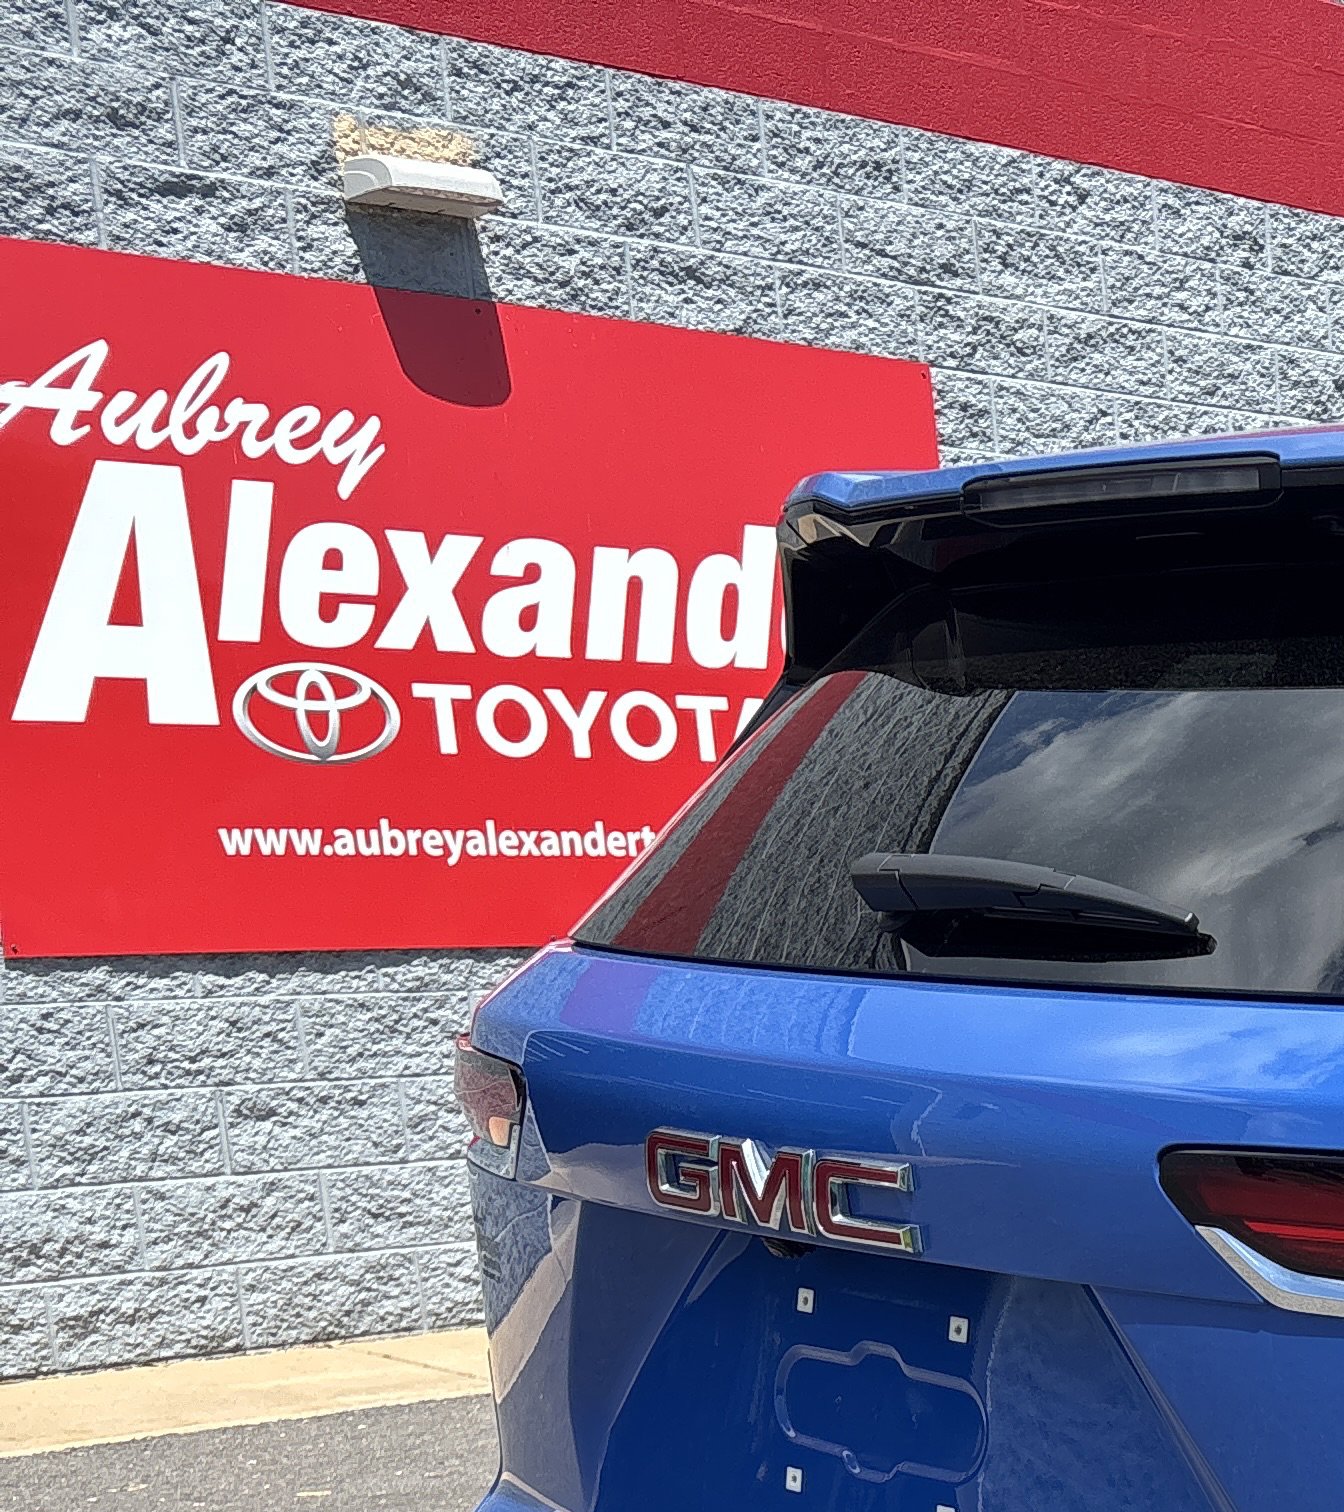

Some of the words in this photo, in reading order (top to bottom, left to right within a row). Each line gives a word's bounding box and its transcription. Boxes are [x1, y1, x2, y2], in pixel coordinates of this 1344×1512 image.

[0, 339, 386, 501] Aubrey
[12, 460, 787, 726] Alexand
[217, 818, 657, 868] www.aubreyalexandert
[644, 1126, 924, 1254] GMC
